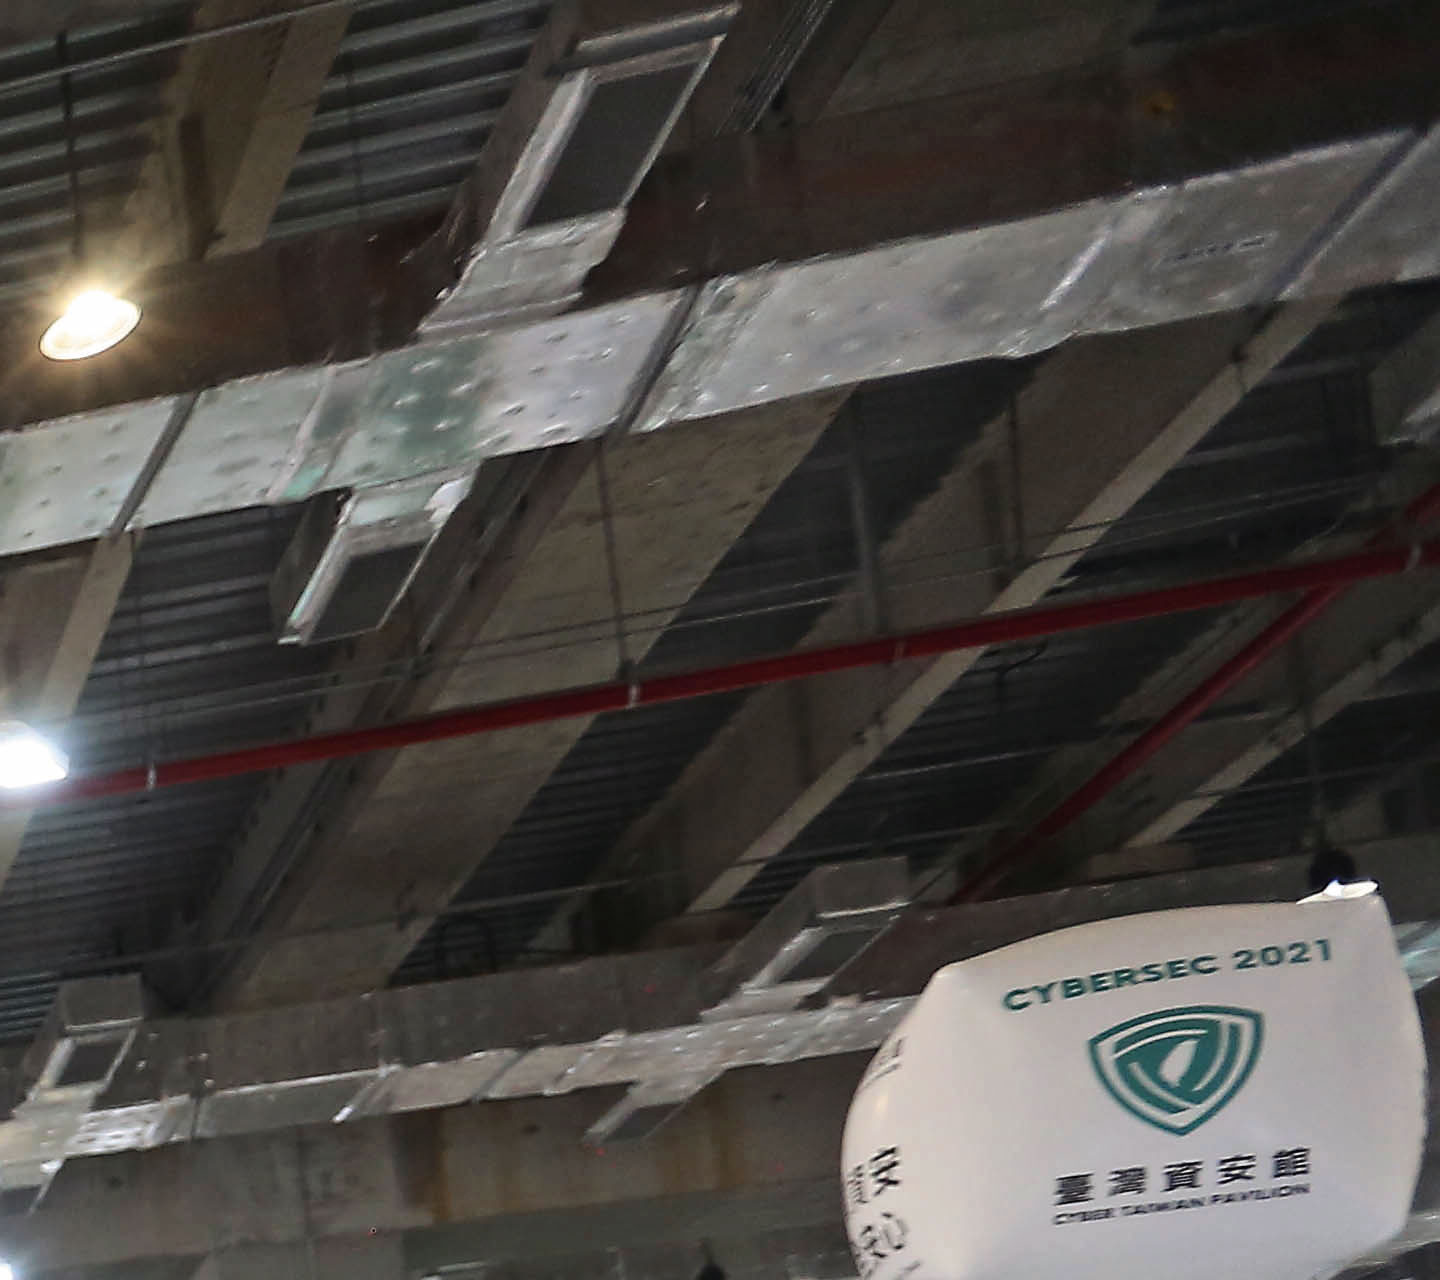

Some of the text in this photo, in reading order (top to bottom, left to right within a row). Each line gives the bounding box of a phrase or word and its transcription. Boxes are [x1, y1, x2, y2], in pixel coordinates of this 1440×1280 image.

[1003, 939, 1332, 1012] CYBERSEC 2021
[1053, 1148, 1311, 1207] 臺灣資安館
